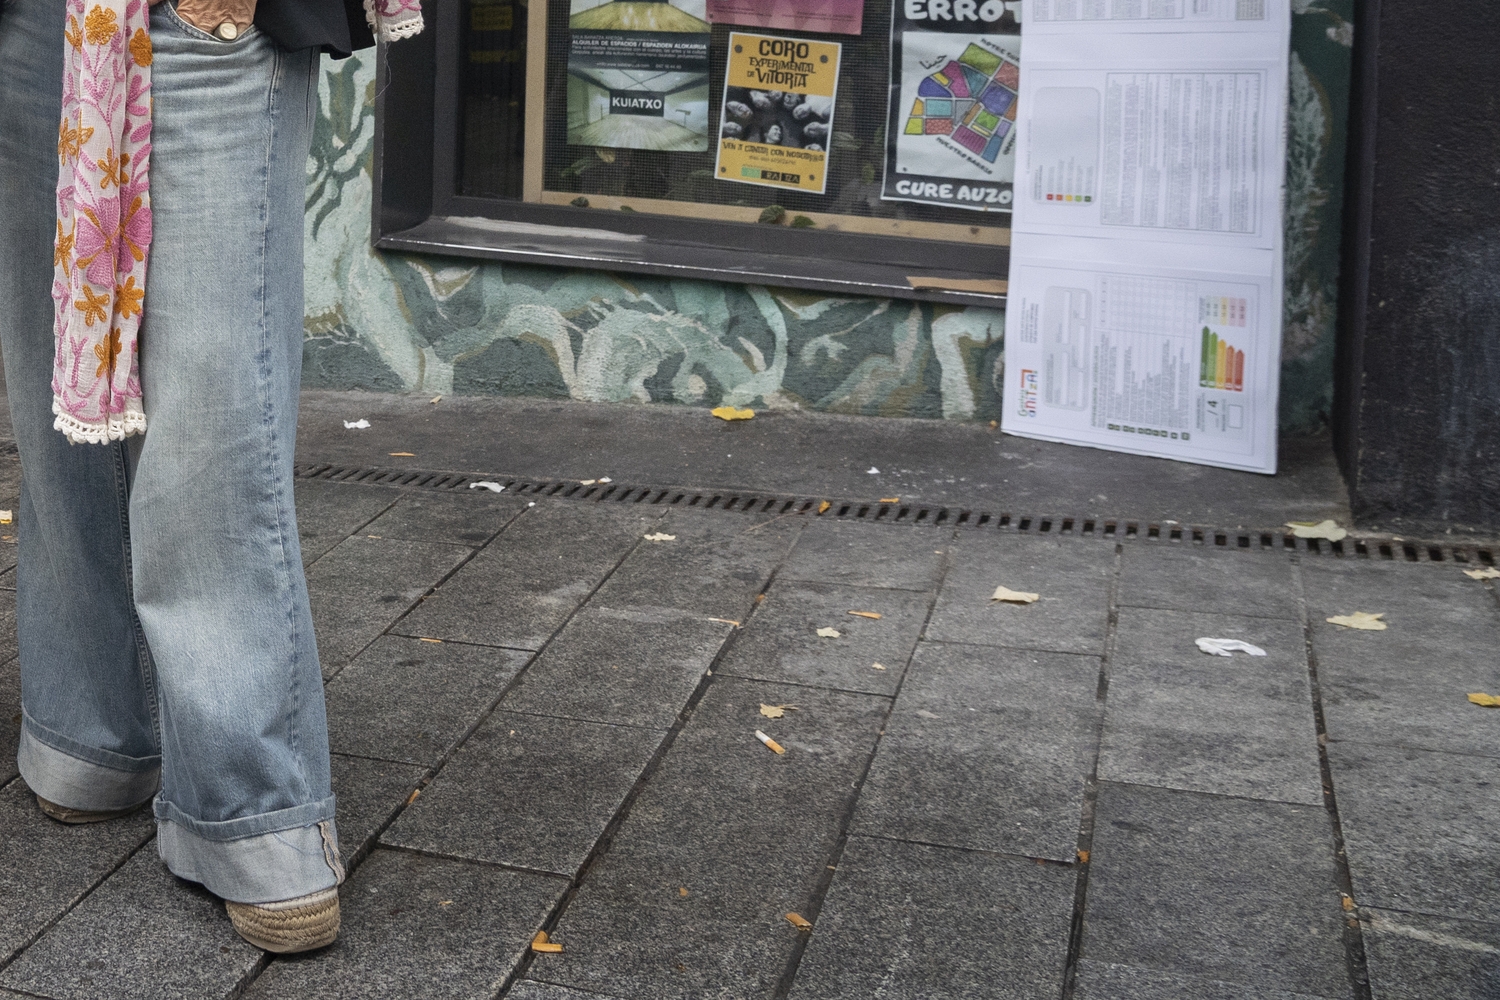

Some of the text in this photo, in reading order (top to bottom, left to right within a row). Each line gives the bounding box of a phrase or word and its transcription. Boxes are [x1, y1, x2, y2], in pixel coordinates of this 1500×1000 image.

[759, 39, 810, 63] CORO
[749, 56, 817, 74] EXPERIMENTAL
[755, 68, 809, 89] VITORIA
[612, 97, 662, 110] KUIATXO
